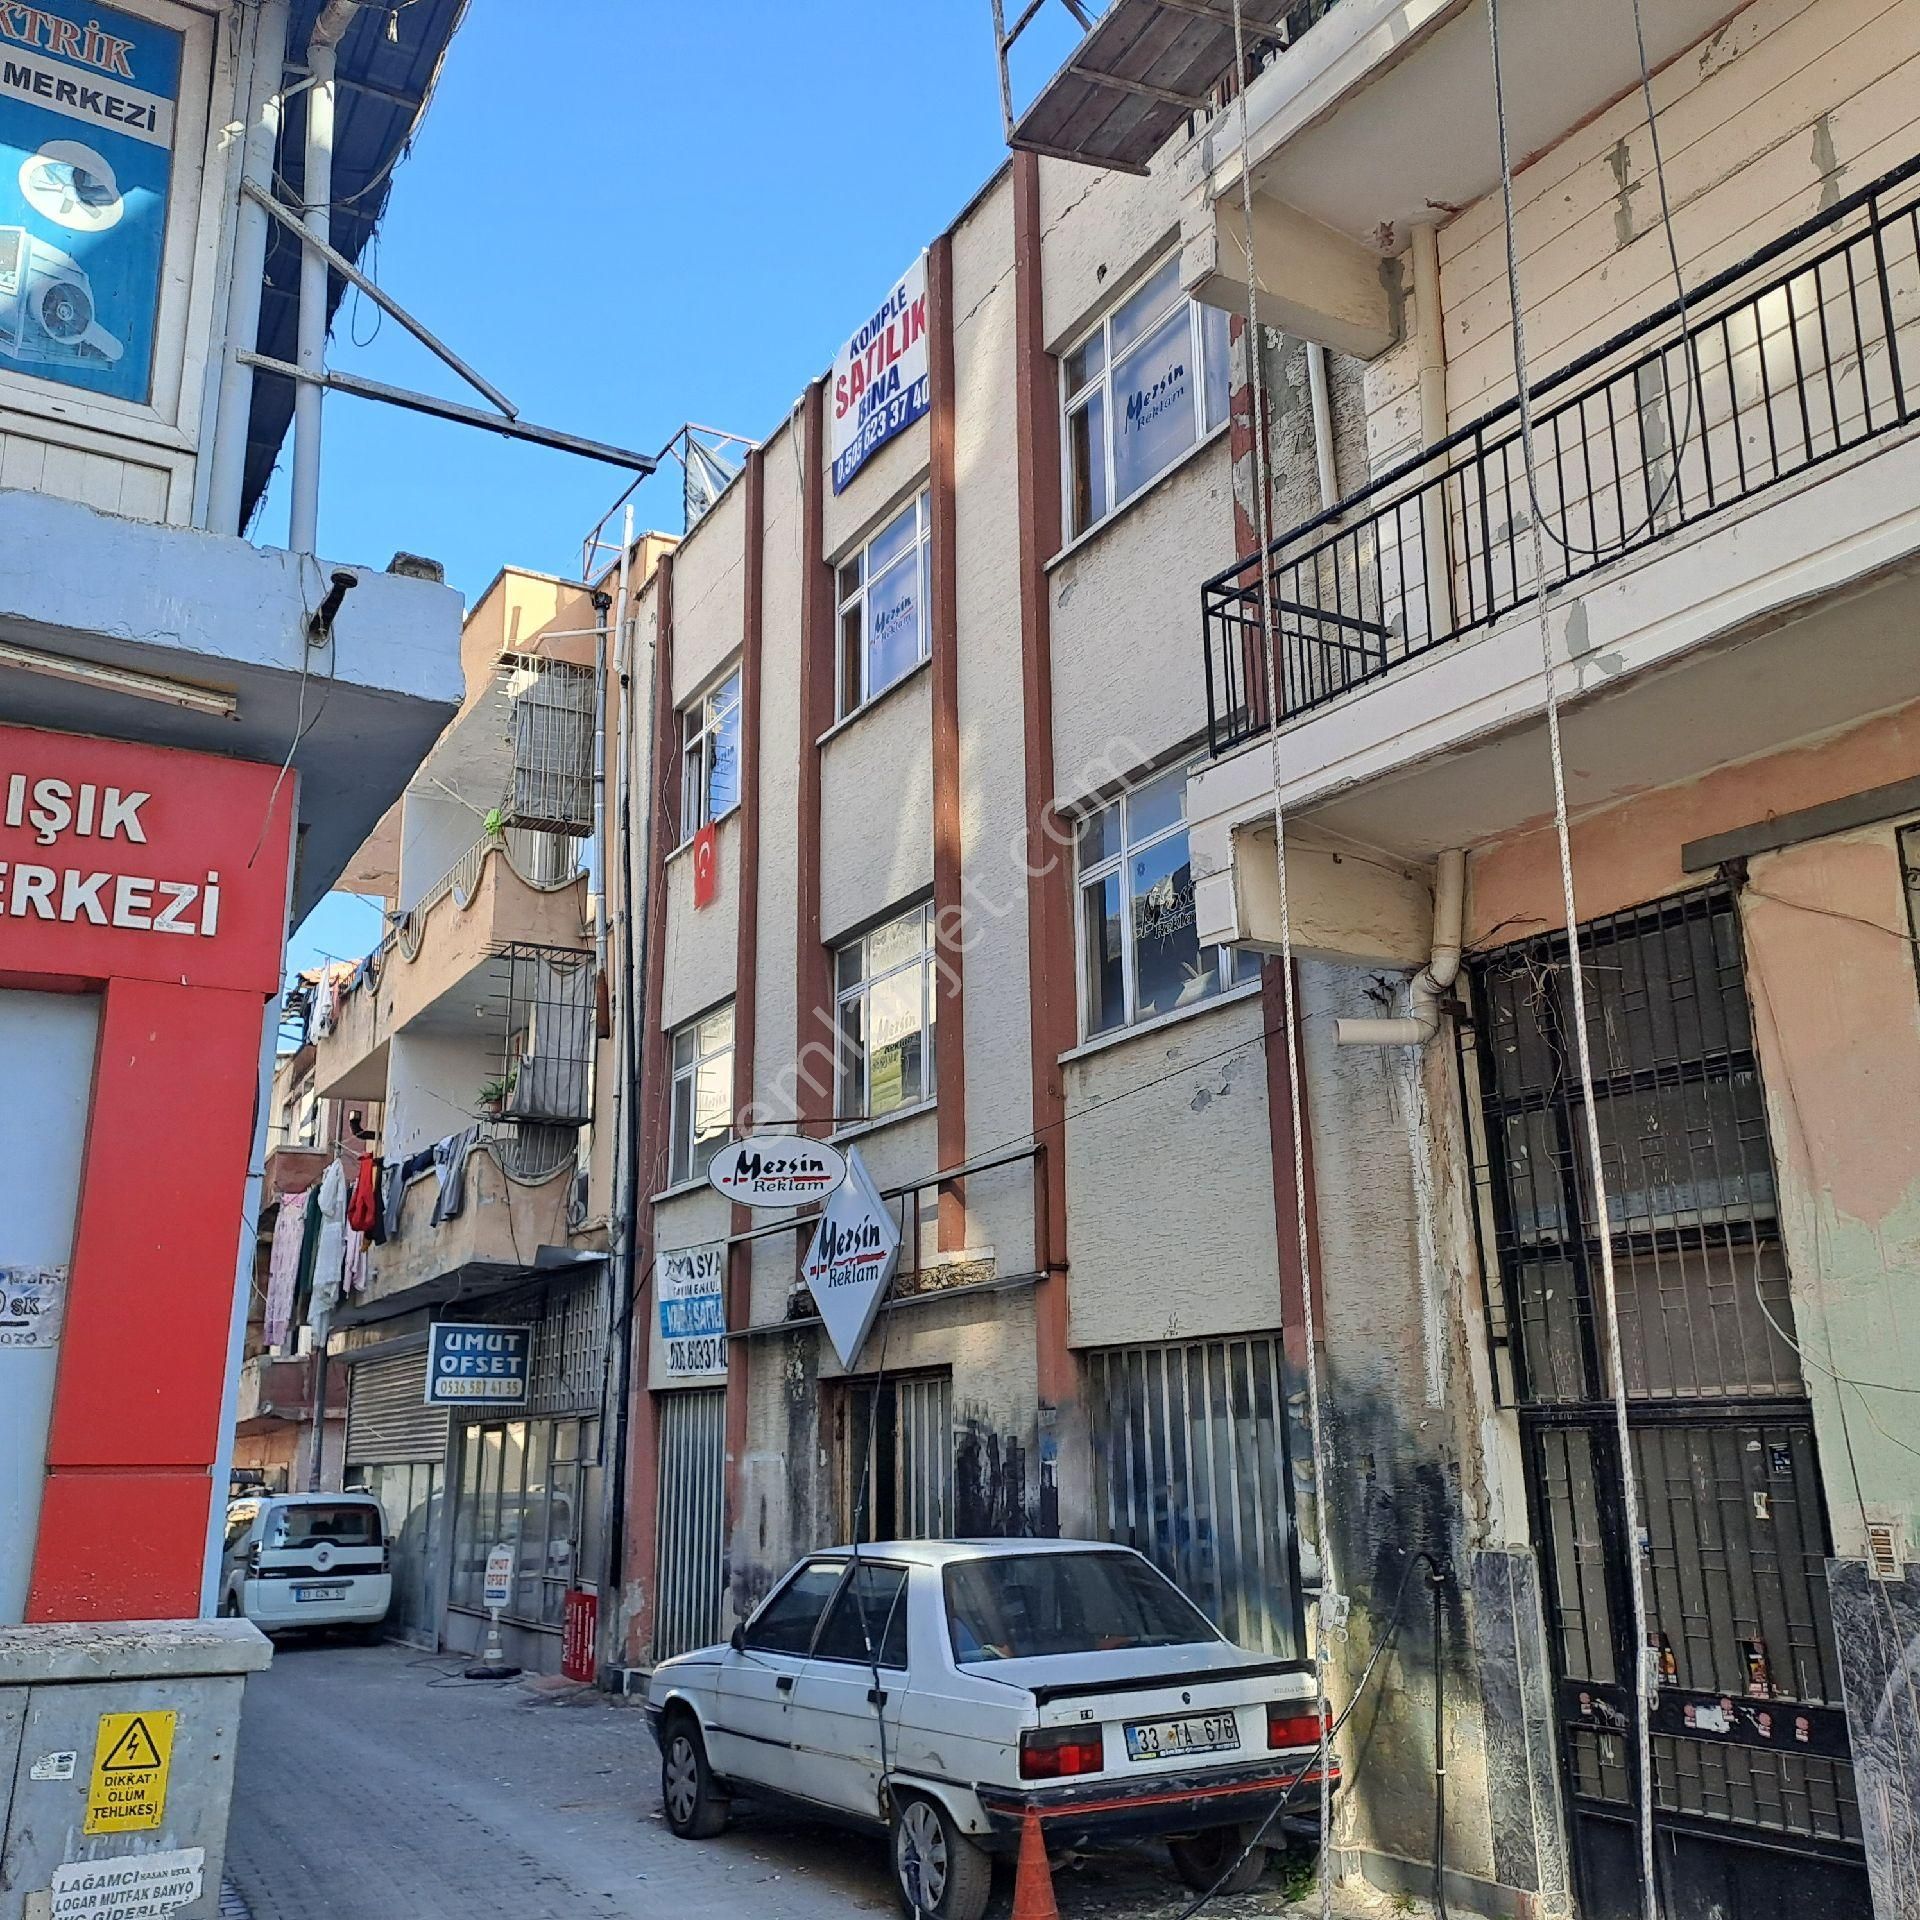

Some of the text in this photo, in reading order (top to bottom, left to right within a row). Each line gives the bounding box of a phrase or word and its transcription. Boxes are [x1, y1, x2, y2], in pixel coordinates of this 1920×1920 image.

[3, 61, 156, 132] MERKEZİ
[850, 283, 907, 360] KOMPLE
[836, 292, 926, 419] SATILIK
[864, 409, 887, 450] 623
[889, 389, 908, 428] 37
[912, 376, 929, 412] 40
[1137, 386, 1185, 432] Reklam
[5, 774, 151, 845] IŞIK
[0, 862, 220, 937] RKEZİ
[733, 1150, 824, 1185] Mersin
[753, 1179, 824, 1192] Reklam
[816, 1214, 880, 1280] Mersin
[828, 1264, 878, 1288] Reklam
[444, 1332, 520, 1351] UMUT
[440, 1356, 521, 1375] OFSET
[441, 1380, 466, 1395] 0536
[1138, 1727, 1159, 1751] 33
[1171, 1722, 1193, 1747] TA
[1203, 1718, 1234, 1742] 676
[104, 1772, 152, 1786] DİKKAT
[108, 1787, 145, 1802] ÖLÜM
[55, 1880, 194, 1913] LOGAR MUTFAK BANYO
